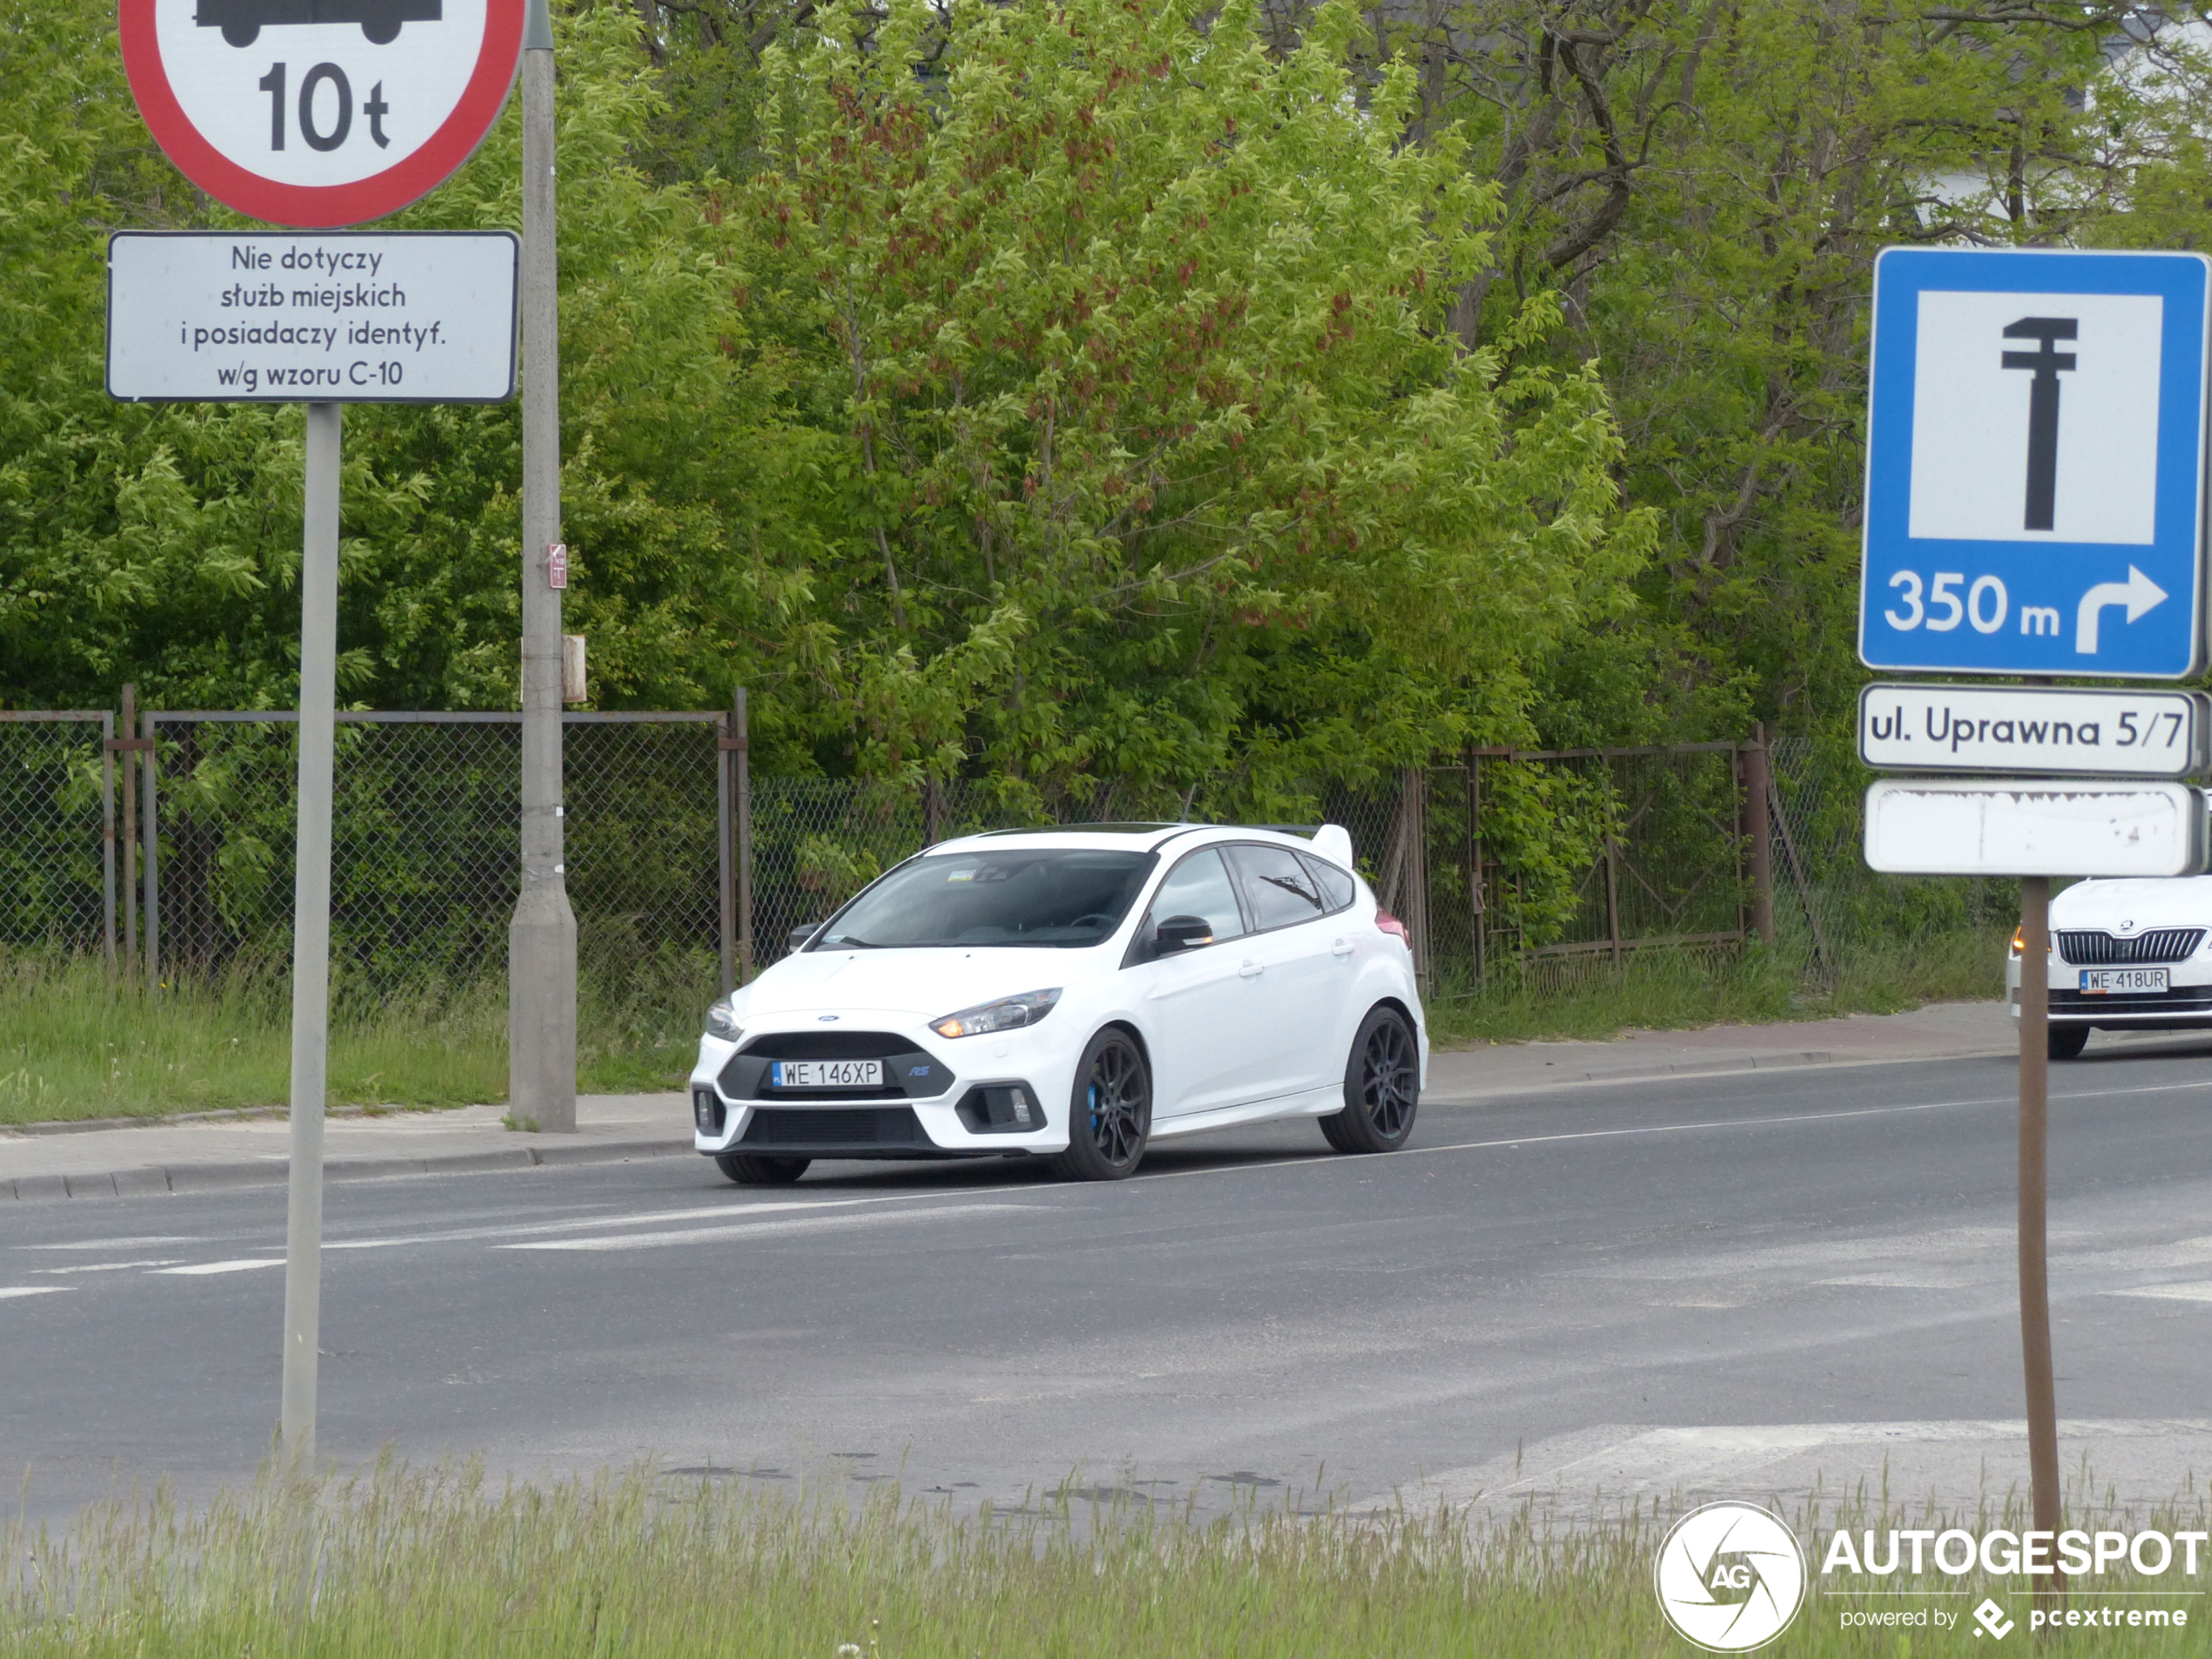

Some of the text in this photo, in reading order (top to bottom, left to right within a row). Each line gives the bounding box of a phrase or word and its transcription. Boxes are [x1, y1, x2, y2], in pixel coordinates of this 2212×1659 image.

[233, 246, 382, 276] Nie dotyczy
[221, 283, 405, 314] służb miejskich
[181, 320, 445, 352] i posiadaczy identyf.
[218, 361, 402, 392] w/g wzoru C-10
[1885, 570, 2059, 635] 350 m
[1872, 706, 2182, 752] ul. Uprawna 5/7
[2091, 972, 2163, 988] WE 418UR
[786, 1062, 877, 1084] WE 146XP
[909, 1066, 930, 1076] RS
